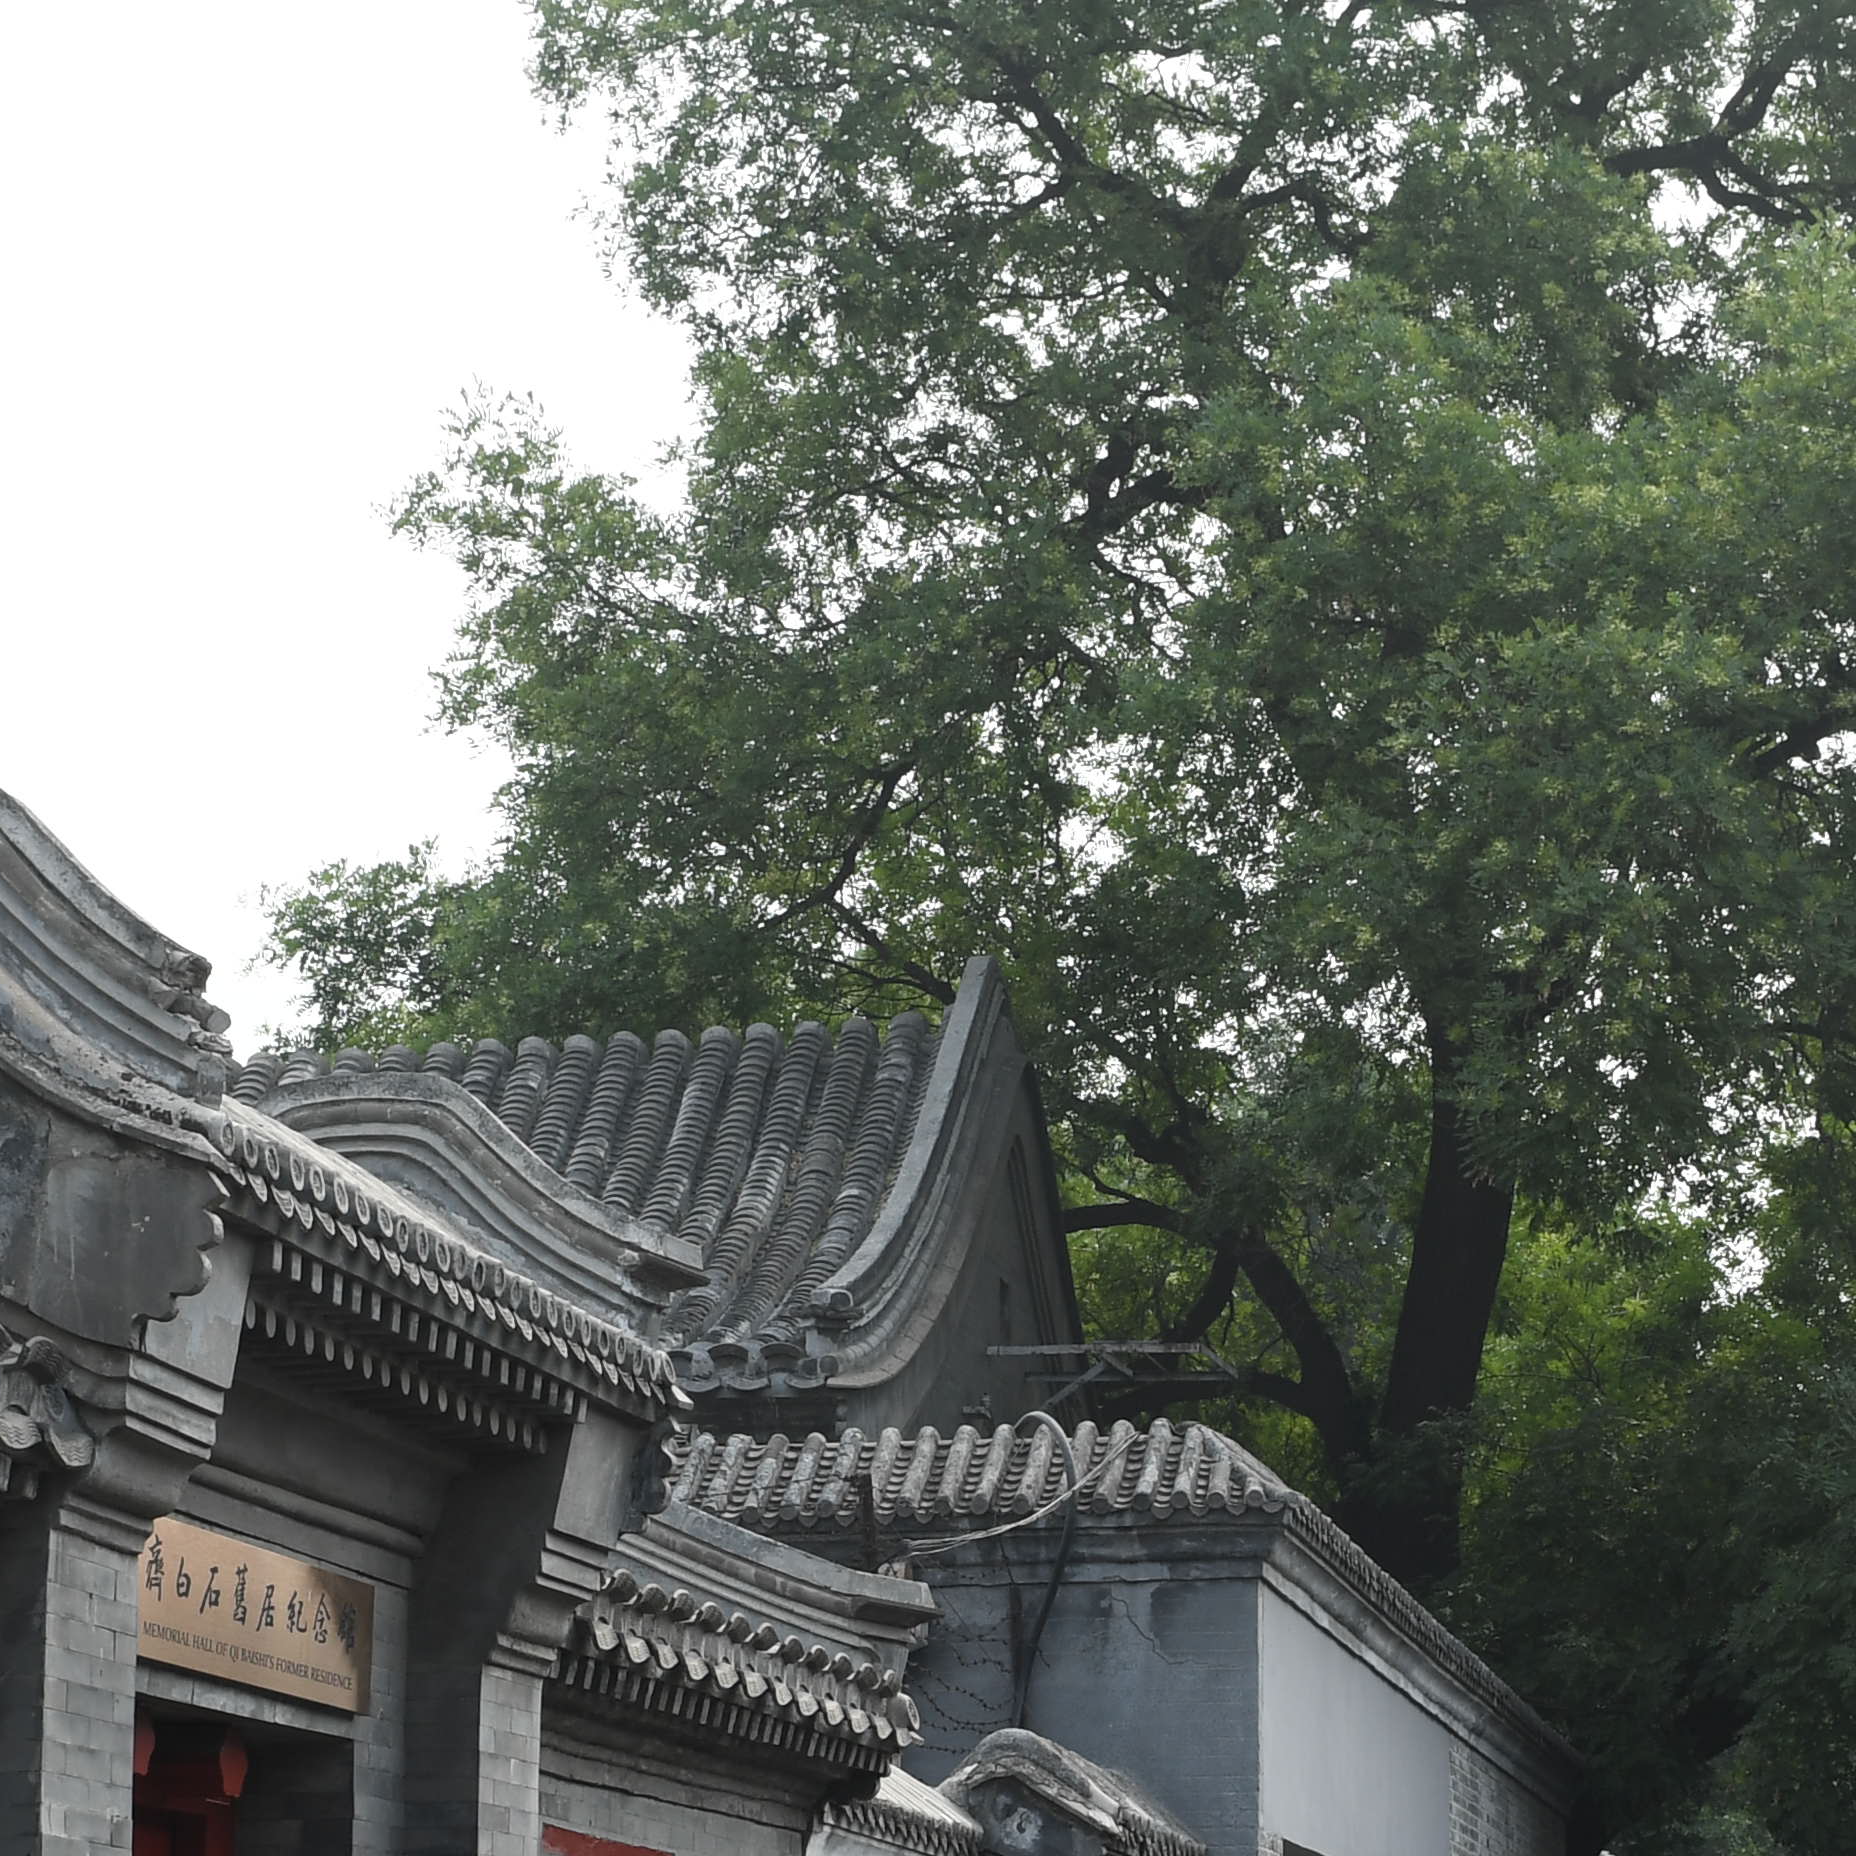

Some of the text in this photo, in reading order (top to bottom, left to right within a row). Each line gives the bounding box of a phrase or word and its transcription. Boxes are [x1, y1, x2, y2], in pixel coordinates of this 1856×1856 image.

[145, 1534, 357, 1655] 齊白石舊居紀念館
[143, 1620, 352, 1691] MEMORIAL HALL OF QI BAISHI'S FORMER RESIDENCE
